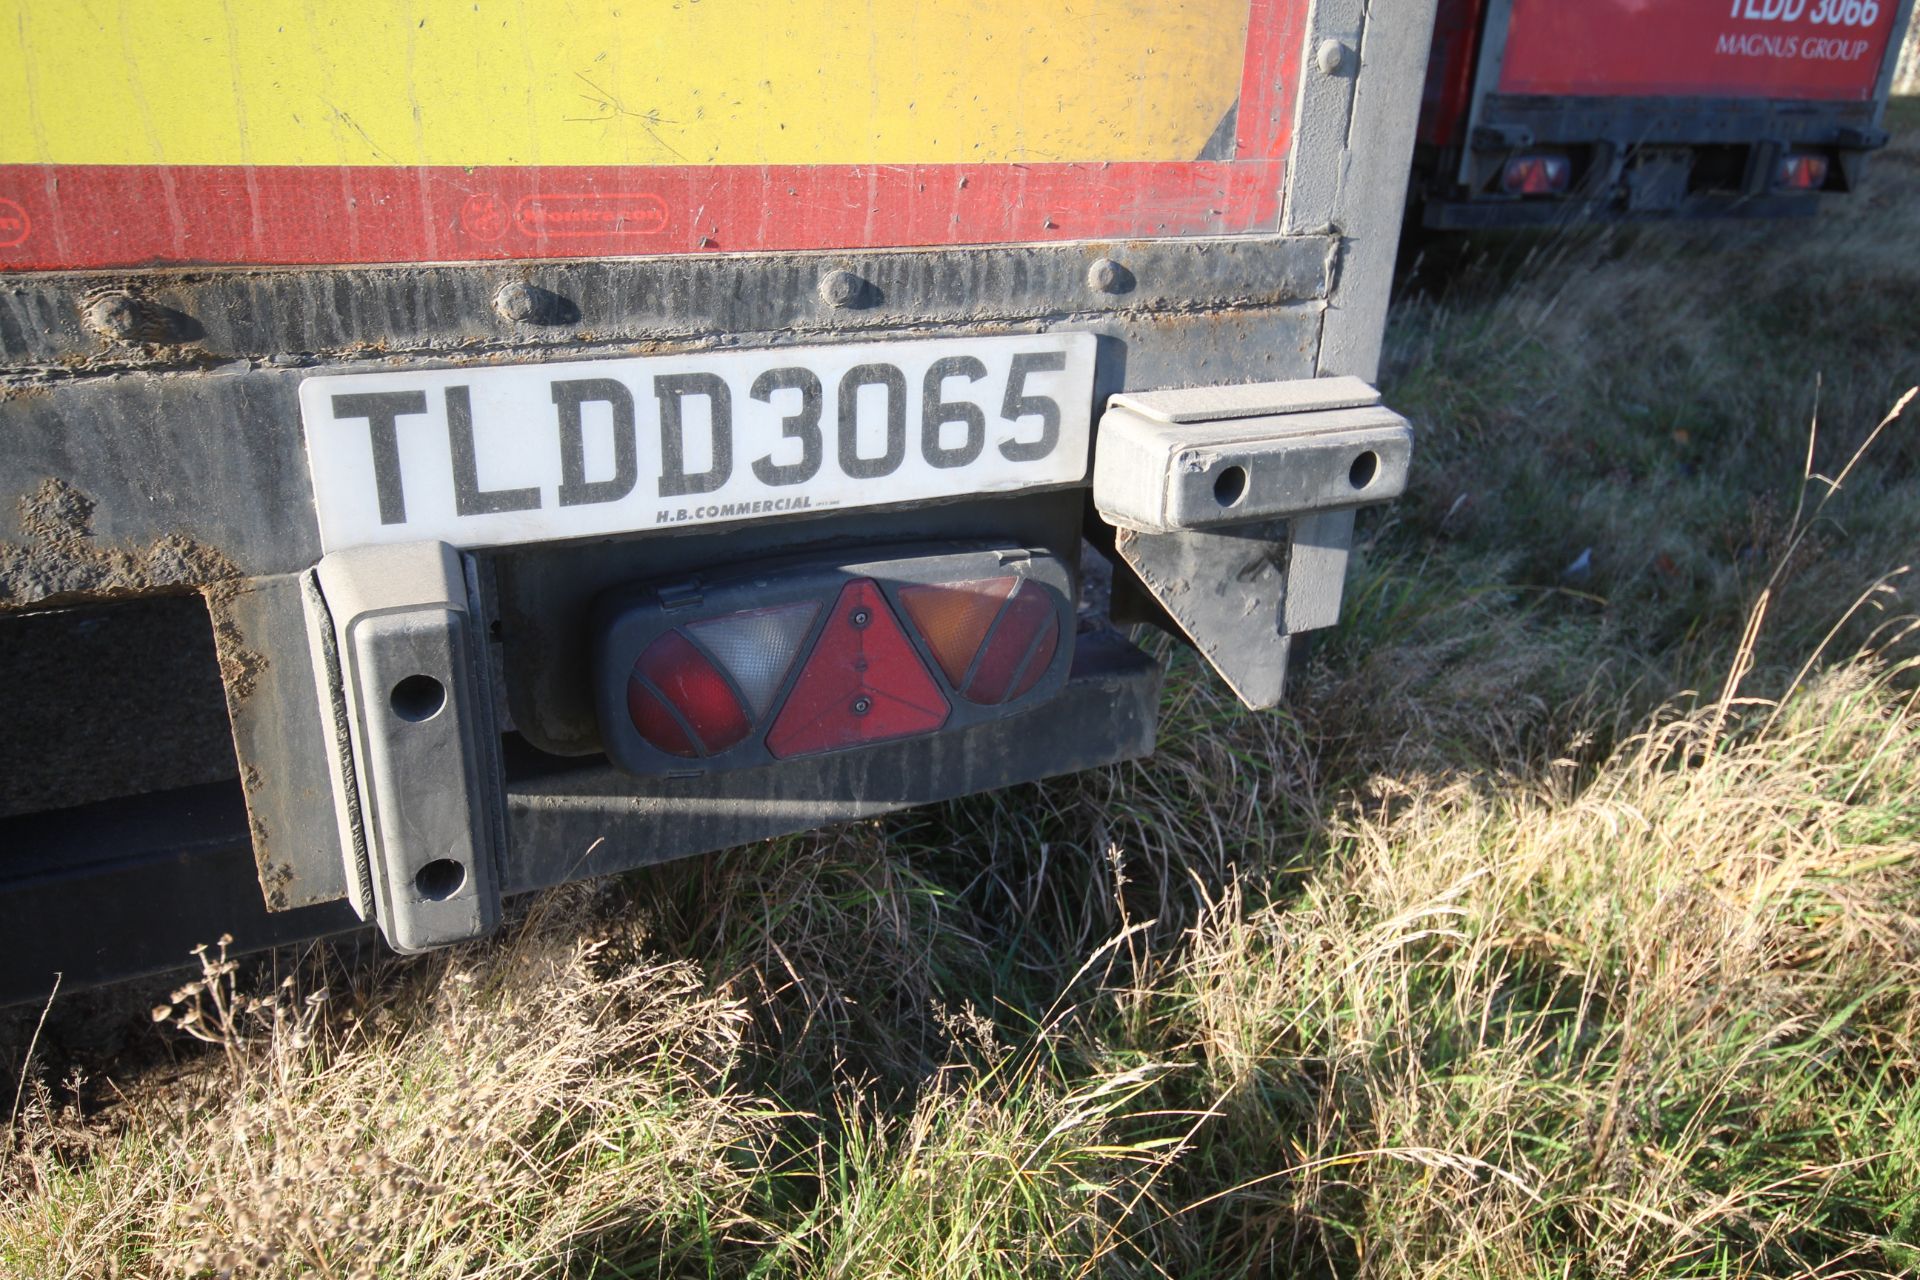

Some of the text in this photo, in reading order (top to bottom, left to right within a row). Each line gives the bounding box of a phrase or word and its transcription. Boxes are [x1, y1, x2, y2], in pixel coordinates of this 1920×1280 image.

[1730, 0, 1880, 26] TLDD 3066
[1716, 34, 1869, 61] MAGNUS GROUP
[331, 350, 1067, 526] TLDD3065
